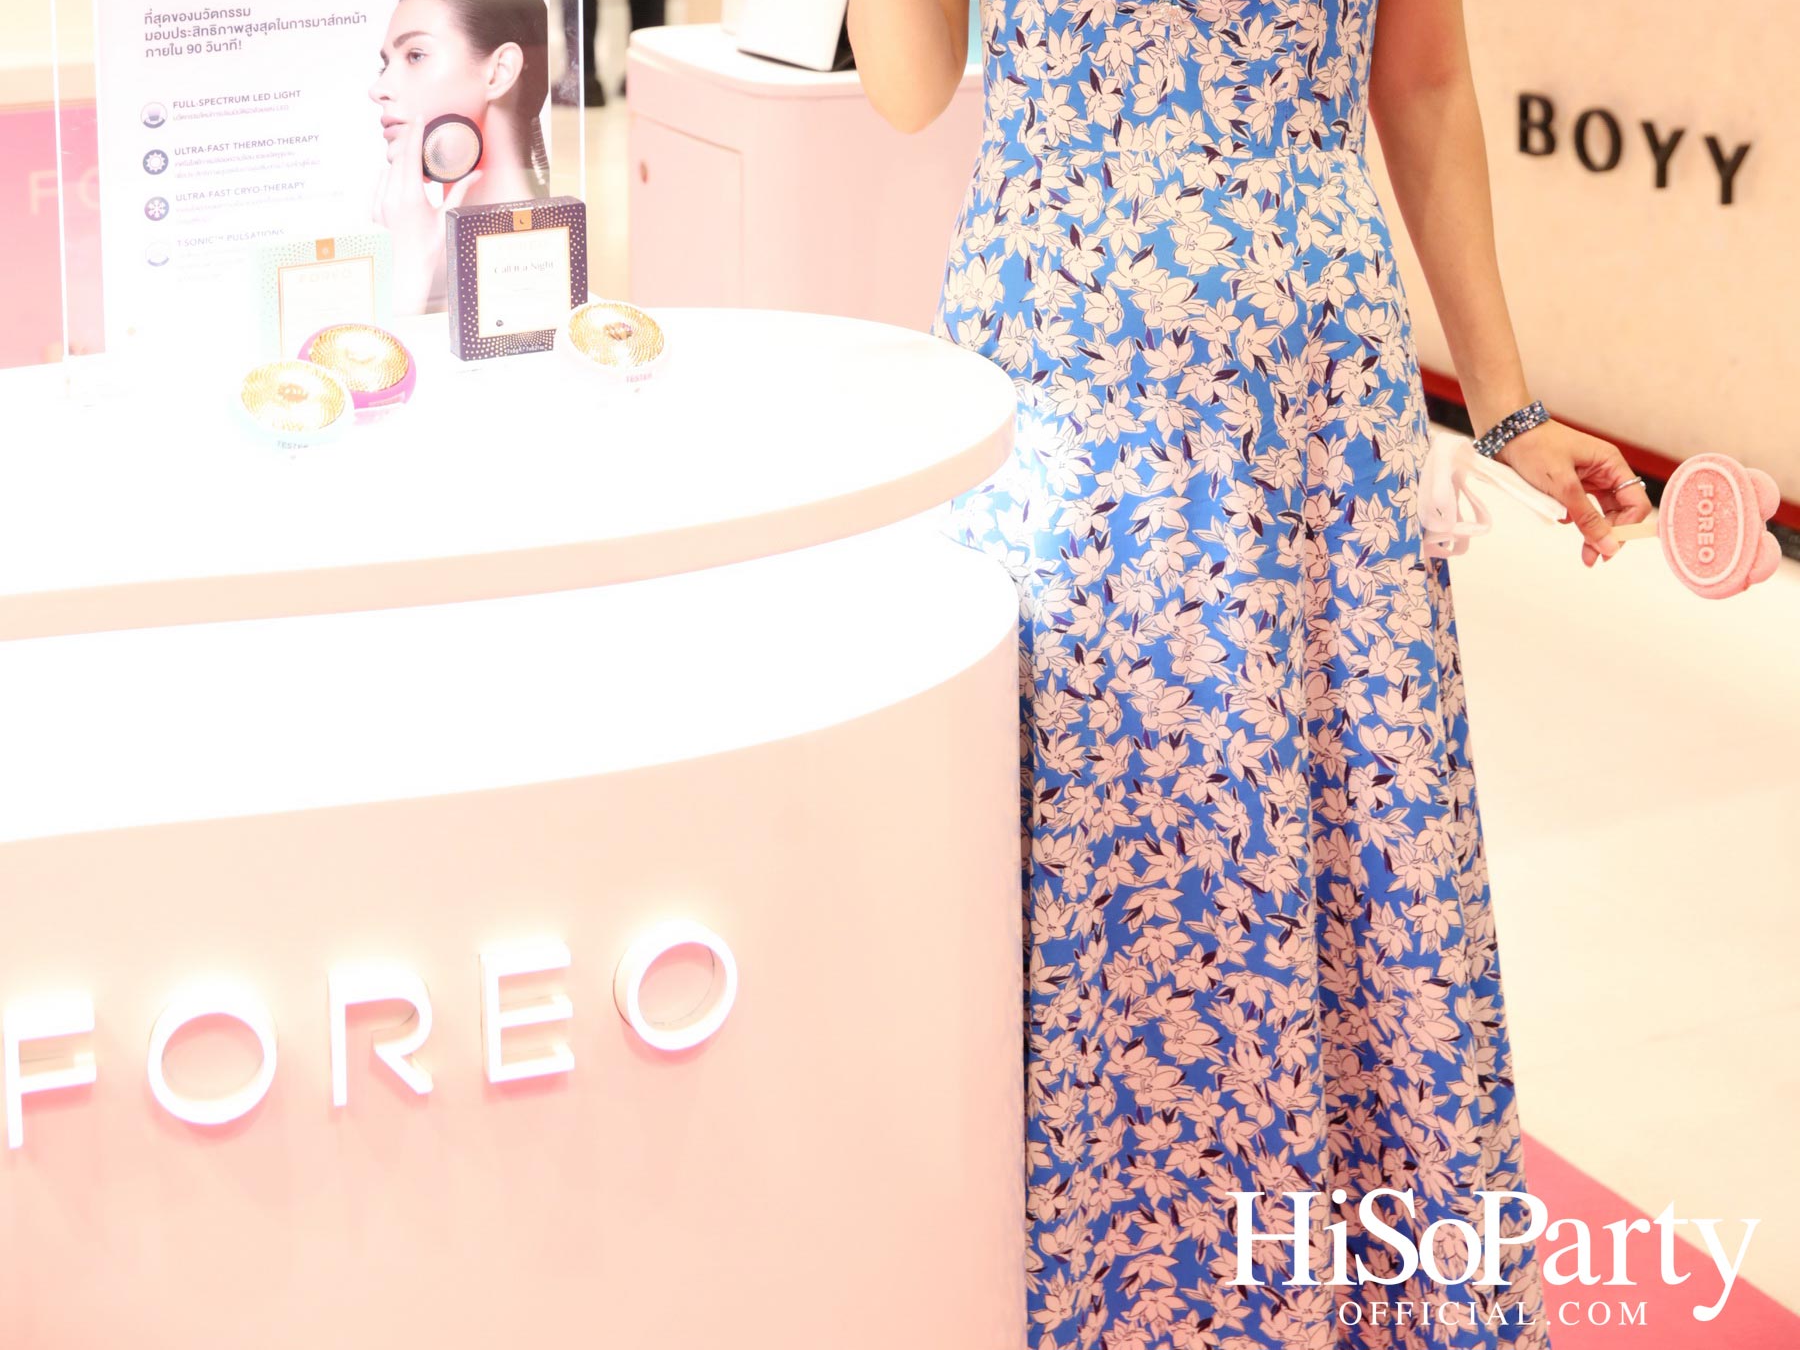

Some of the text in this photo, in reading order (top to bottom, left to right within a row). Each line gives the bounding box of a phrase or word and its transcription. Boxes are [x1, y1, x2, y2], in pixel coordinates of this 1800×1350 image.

[143, 7, 252, 28] ที่สุดของนวัตกรรม
[144, 12, 367, 42] มอบประสิทธิภาพสูงสุดในการมาส์กหน้า
[145, 38, 243, 58] ภายใน 90 วินาที!
[252, 92, 271, 102] LED
[273, 90, 302, 100] LIGHT
[233, 134, 320, 151] THERMO-THERAPY
[1516, 92, 1752, 206] BOYY
[1698, 483, 1715, 564] FOREO
[2, 918, 738, 1148] FOREO
